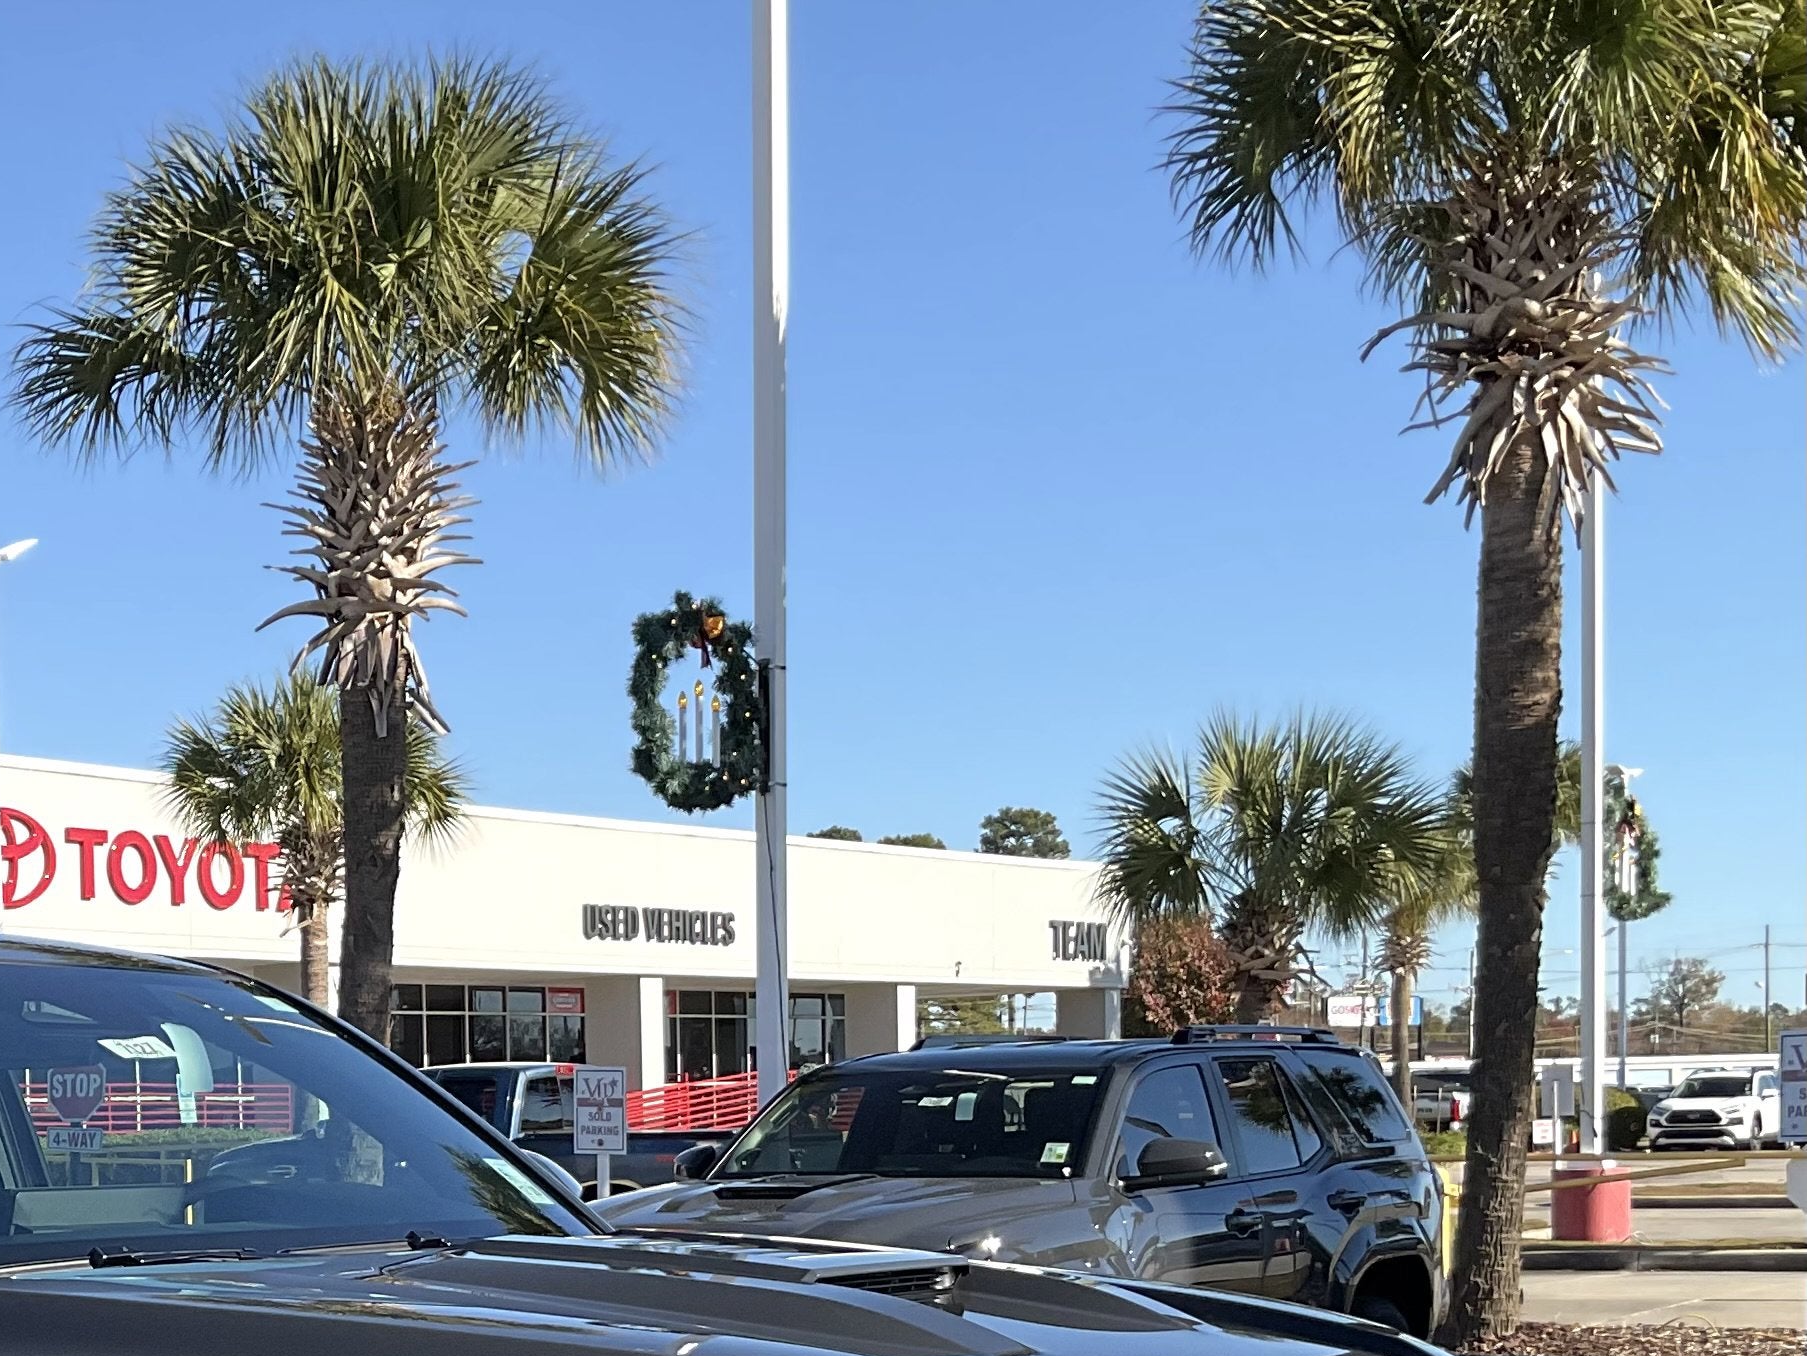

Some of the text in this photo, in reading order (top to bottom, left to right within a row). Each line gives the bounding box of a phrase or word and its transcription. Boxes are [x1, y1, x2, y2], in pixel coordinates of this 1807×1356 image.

[65, 827, 293, 912] TOYOT
[582, 904, 736, 946] USED VEHICLES
[1049, 920, 1107, 962] TEAM
[52, 1073, 101, 1098] STOP
[588, 1112, 612, 1121] SOLD
[51, 1132, 97, 1148] 4-WAY
[580, 1125, 619, 1136] PARKING
